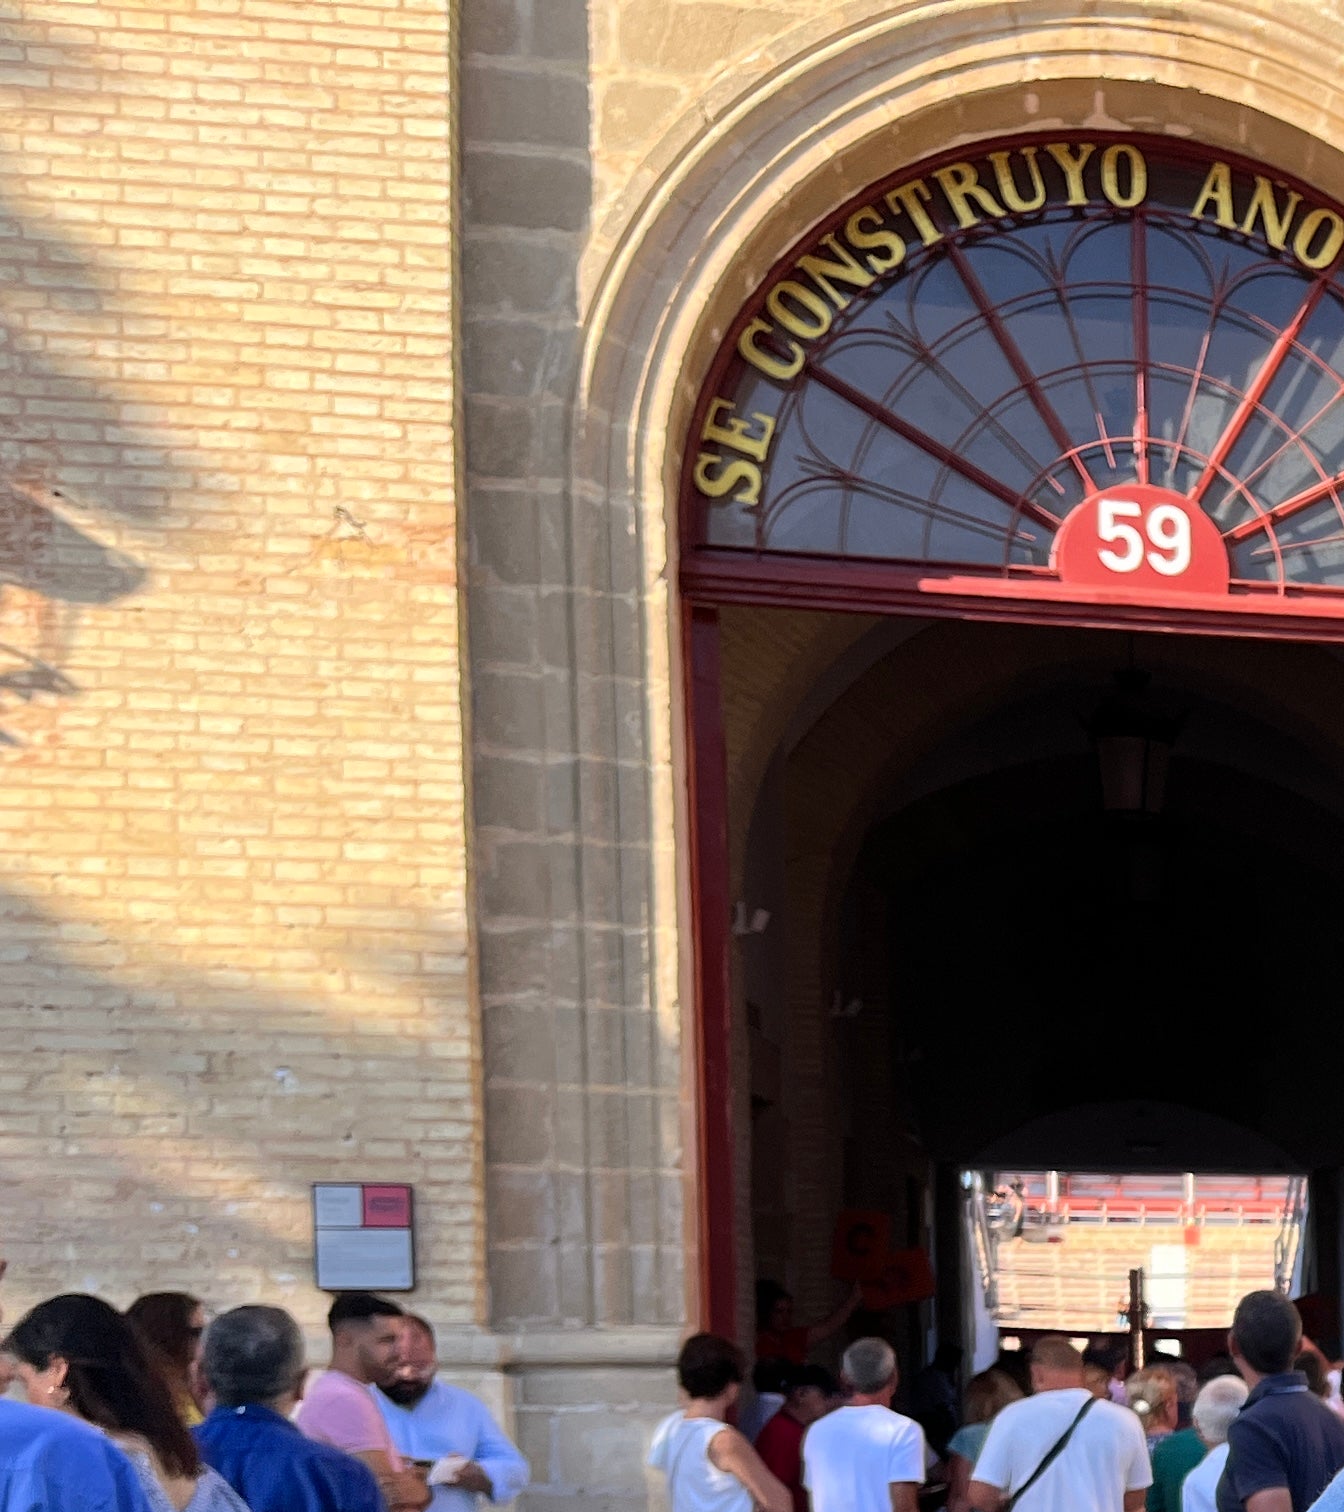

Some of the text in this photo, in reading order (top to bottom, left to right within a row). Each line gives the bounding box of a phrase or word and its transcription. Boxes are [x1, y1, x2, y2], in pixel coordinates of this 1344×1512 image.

[694, 398, 776, 506] SE
[737, 143, 1147, 380] CONSTRUYO
[1097, 499, 1192, 576] 59
